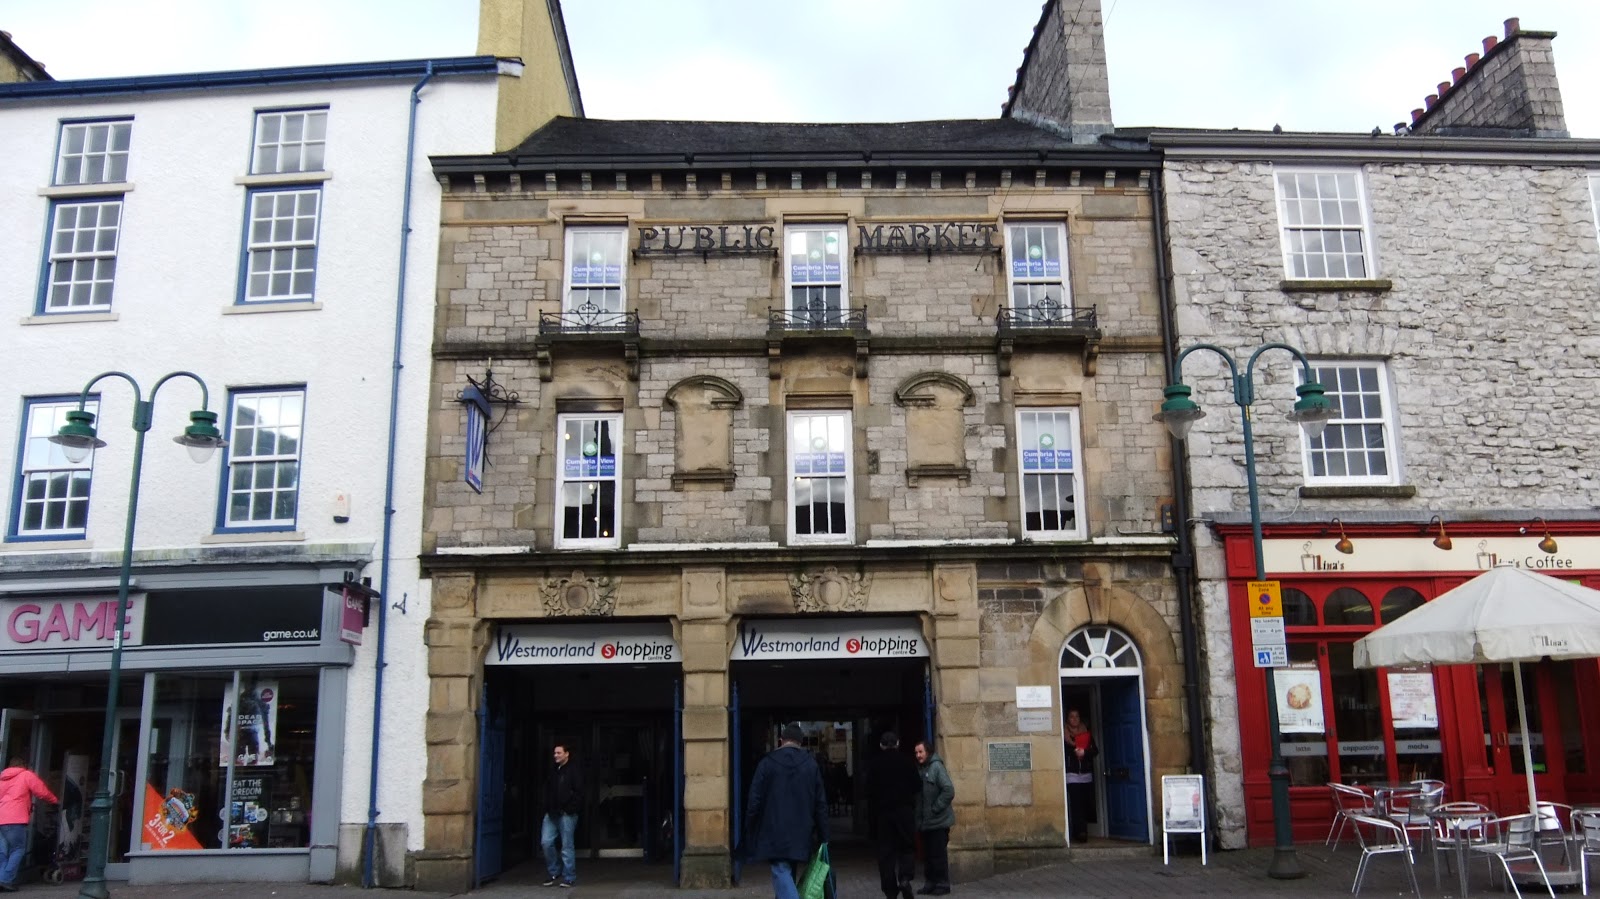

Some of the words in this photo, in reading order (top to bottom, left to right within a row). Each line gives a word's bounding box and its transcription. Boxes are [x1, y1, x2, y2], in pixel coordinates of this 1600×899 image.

[637, 226, 775, 250] PUBLIC
[857, 222, 999, 248] MARKET
[1525, 556, 1573, 568] Coffee
[346, 596, 364, 613] GAME
[7, 601, 133, 643] GAME
[263, 629, 319, 641] game.co.uk
[496, 628, 595, 661] Westmorland
[601, 641, 674, 660] Shopping
[740, 624, 840, 657] Westmorland
[846, 636, 918, 654] Shopping
